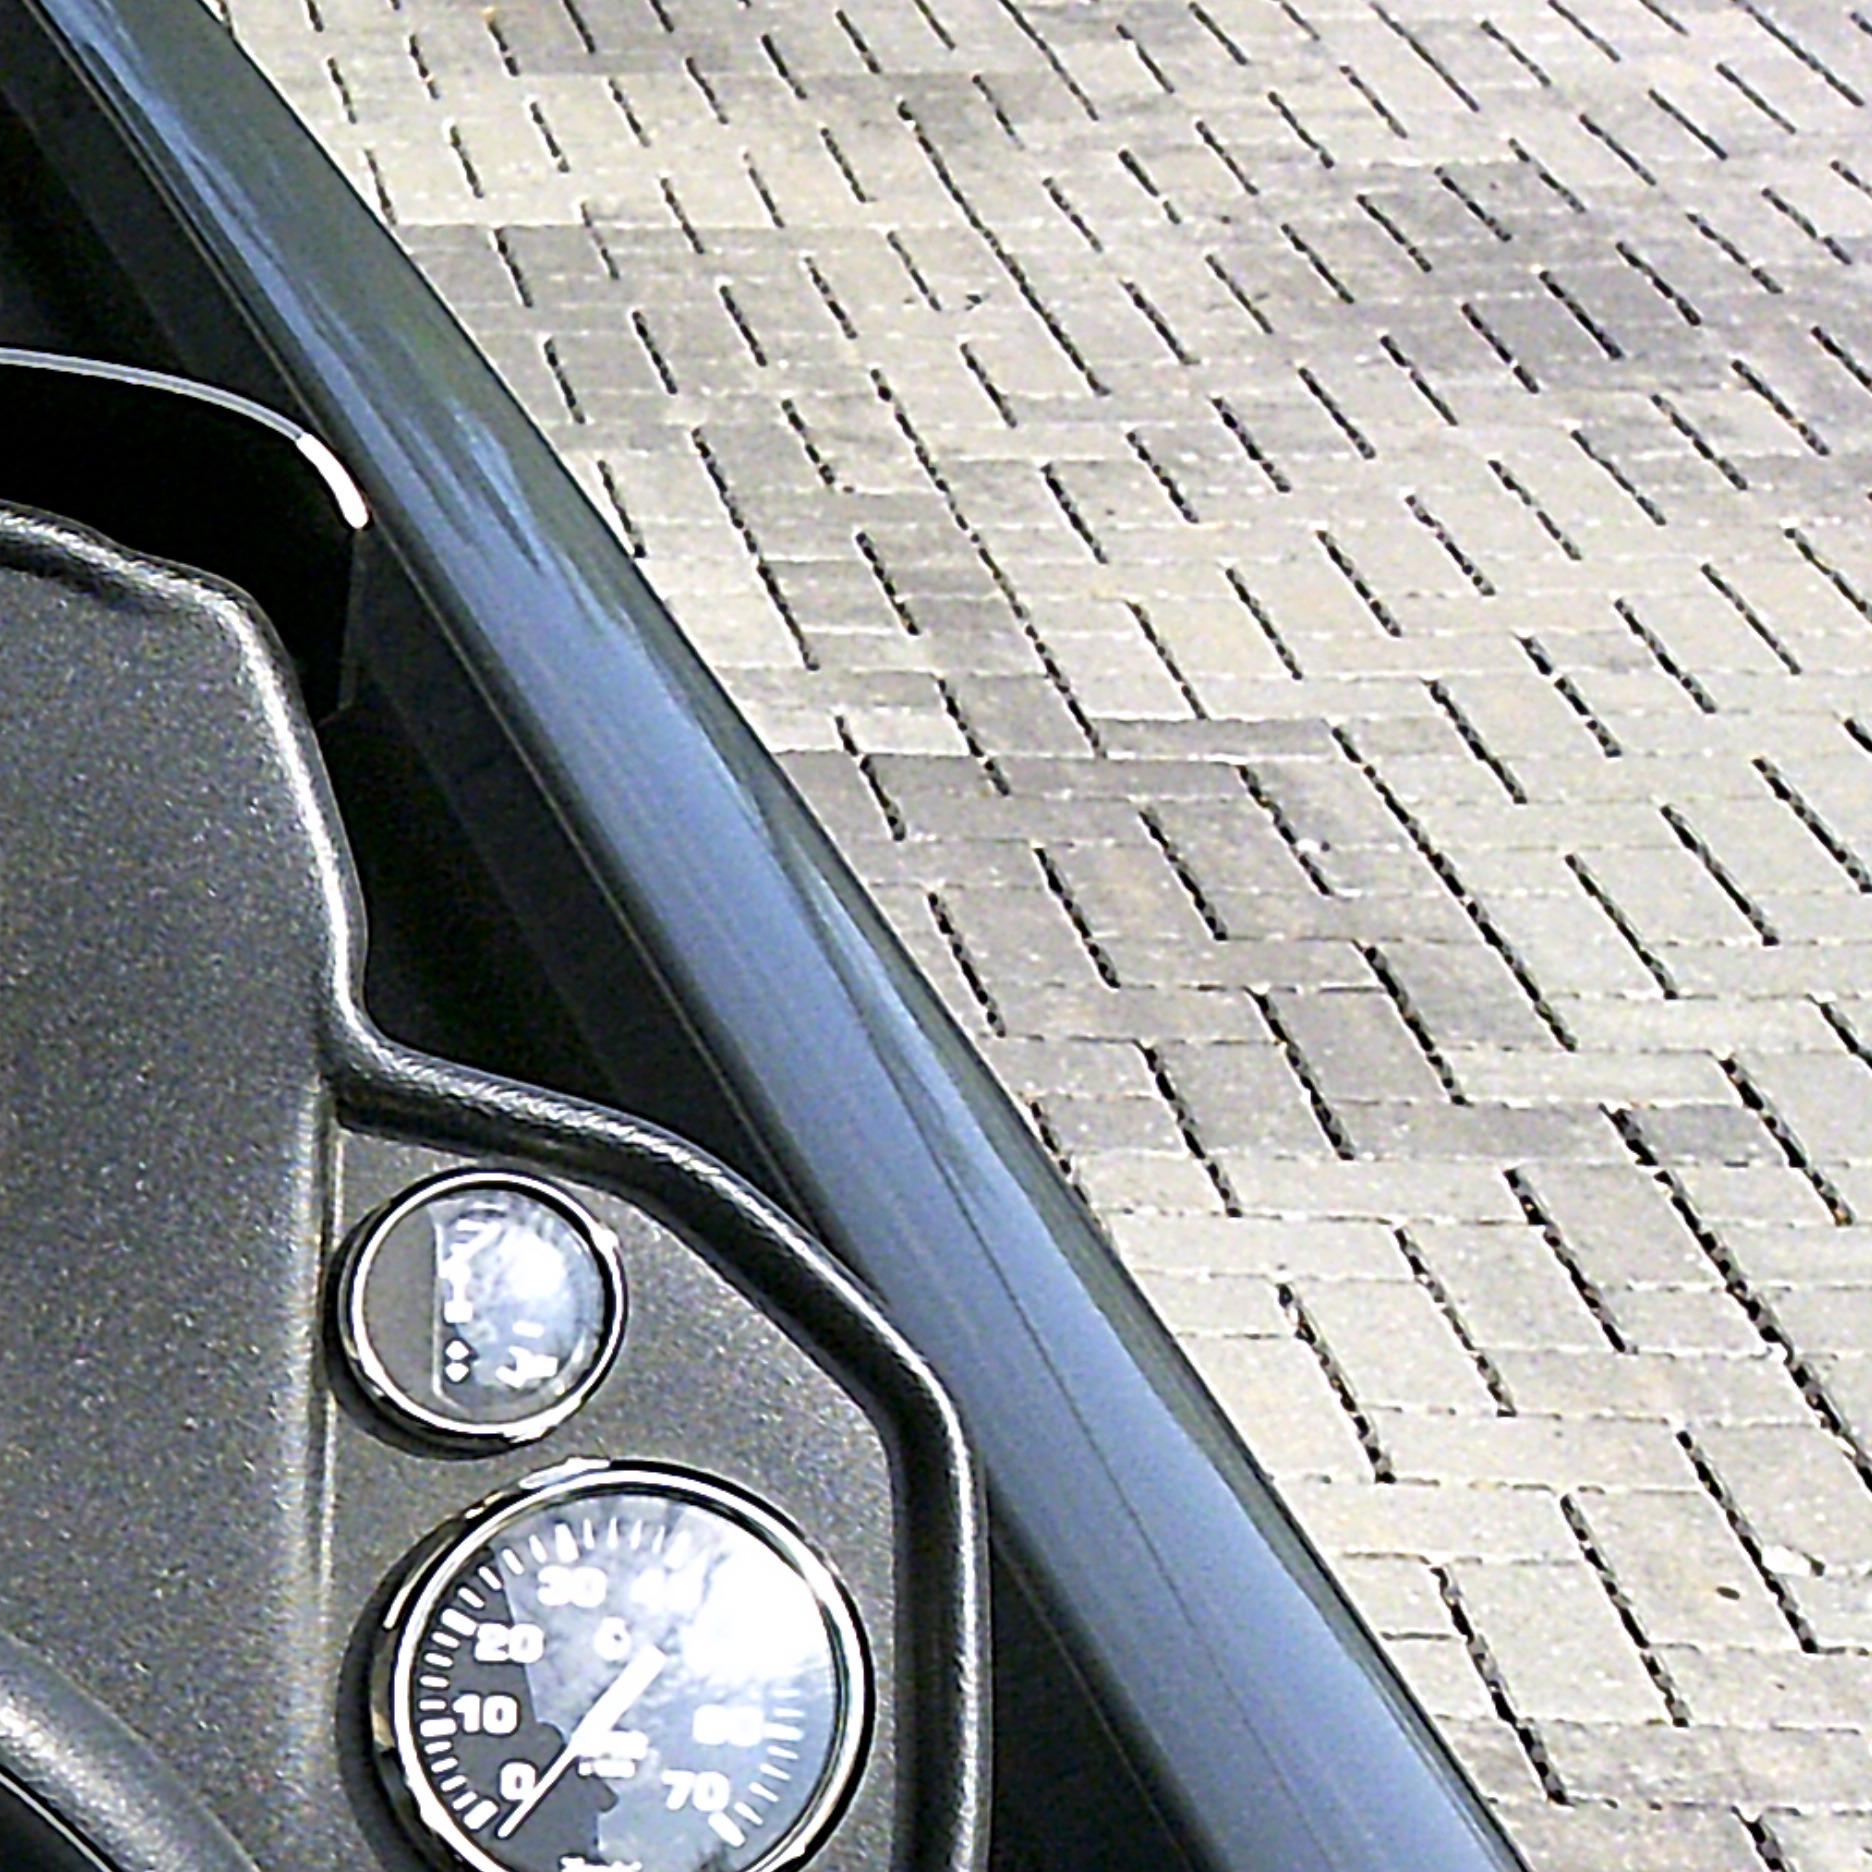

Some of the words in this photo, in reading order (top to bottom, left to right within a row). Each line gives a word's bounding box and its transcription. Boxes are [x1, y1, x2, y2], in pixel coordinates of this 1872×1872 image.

[537, 1565, 607, 1608] 30
[474, 1623, 545, 1663] 20
[452, 1694, 518, 1735] 10
[499, 1760, 538, 1801] 0
[660, 1769, 731, 1812] 70
